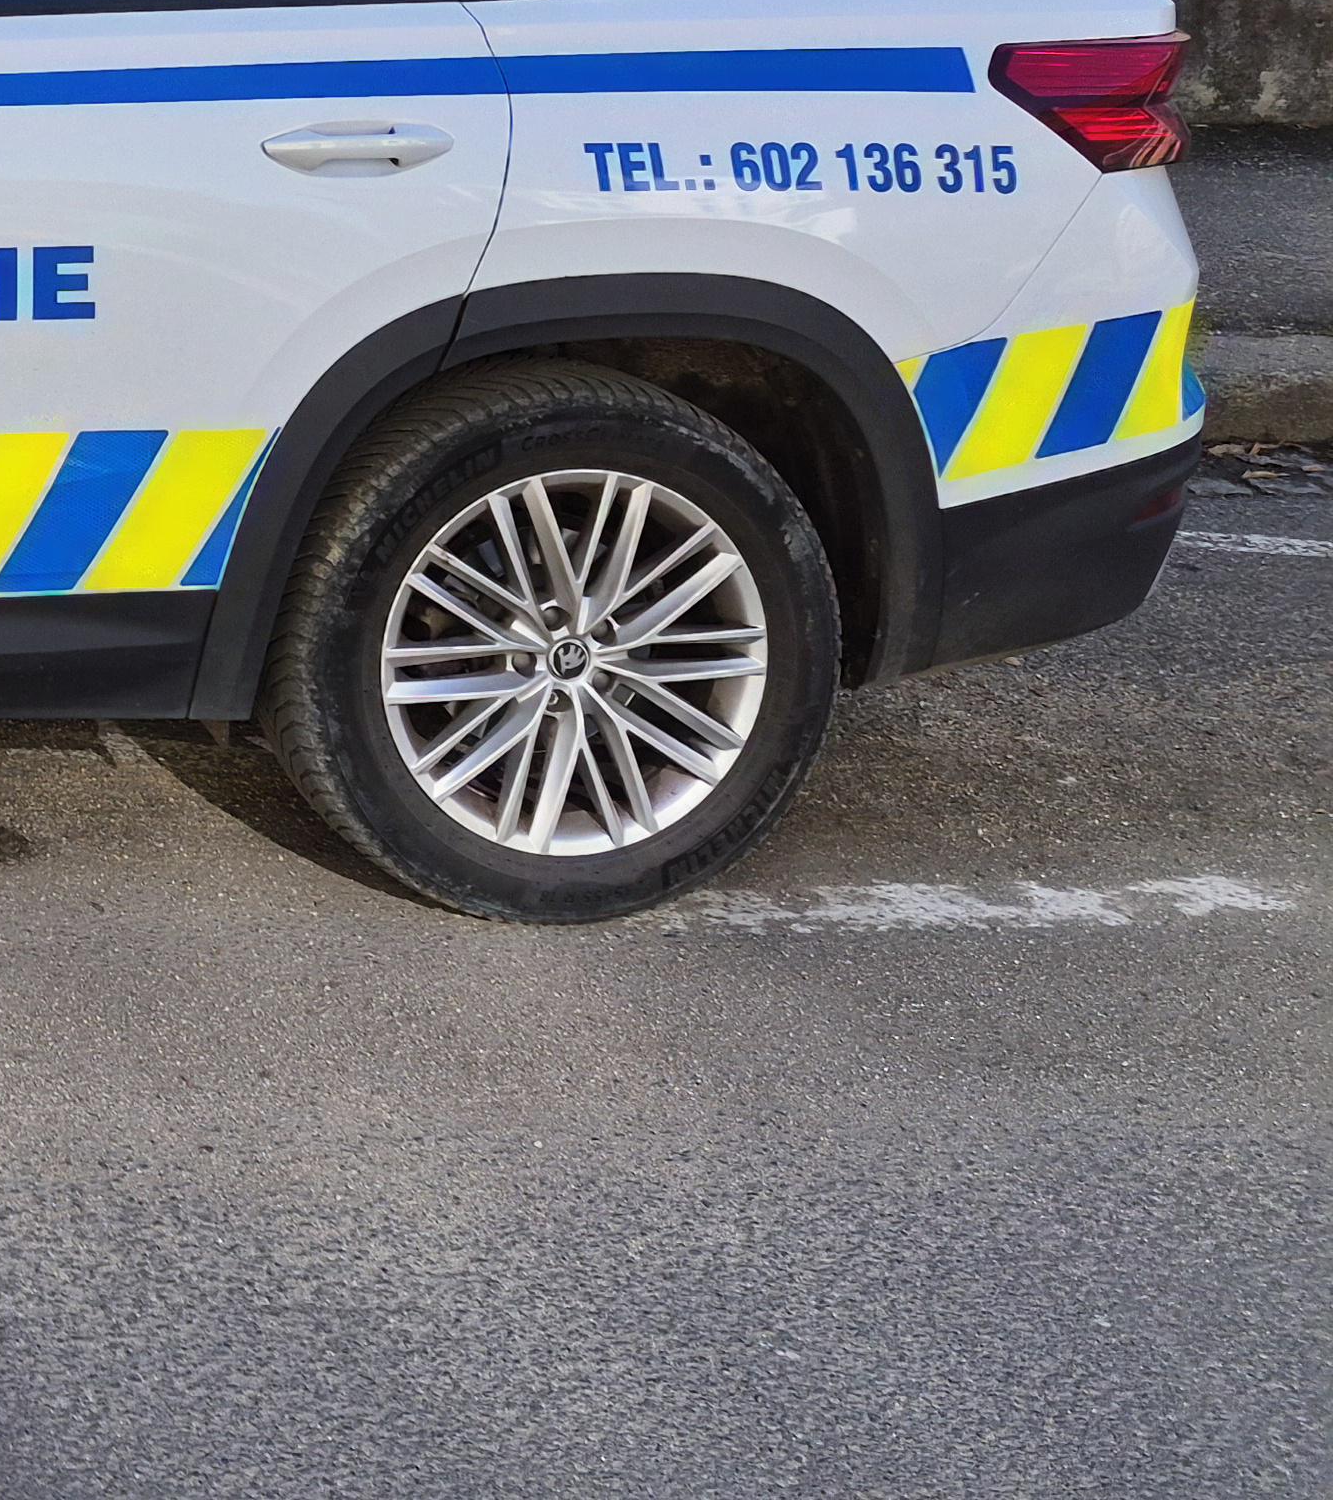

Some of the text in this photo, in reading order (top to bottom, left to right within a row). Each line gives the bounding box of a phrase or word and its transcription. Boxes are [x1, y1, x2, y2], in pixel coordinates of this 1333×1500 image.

[584, 142, 1018, 194] TEL.: 602 136 315
